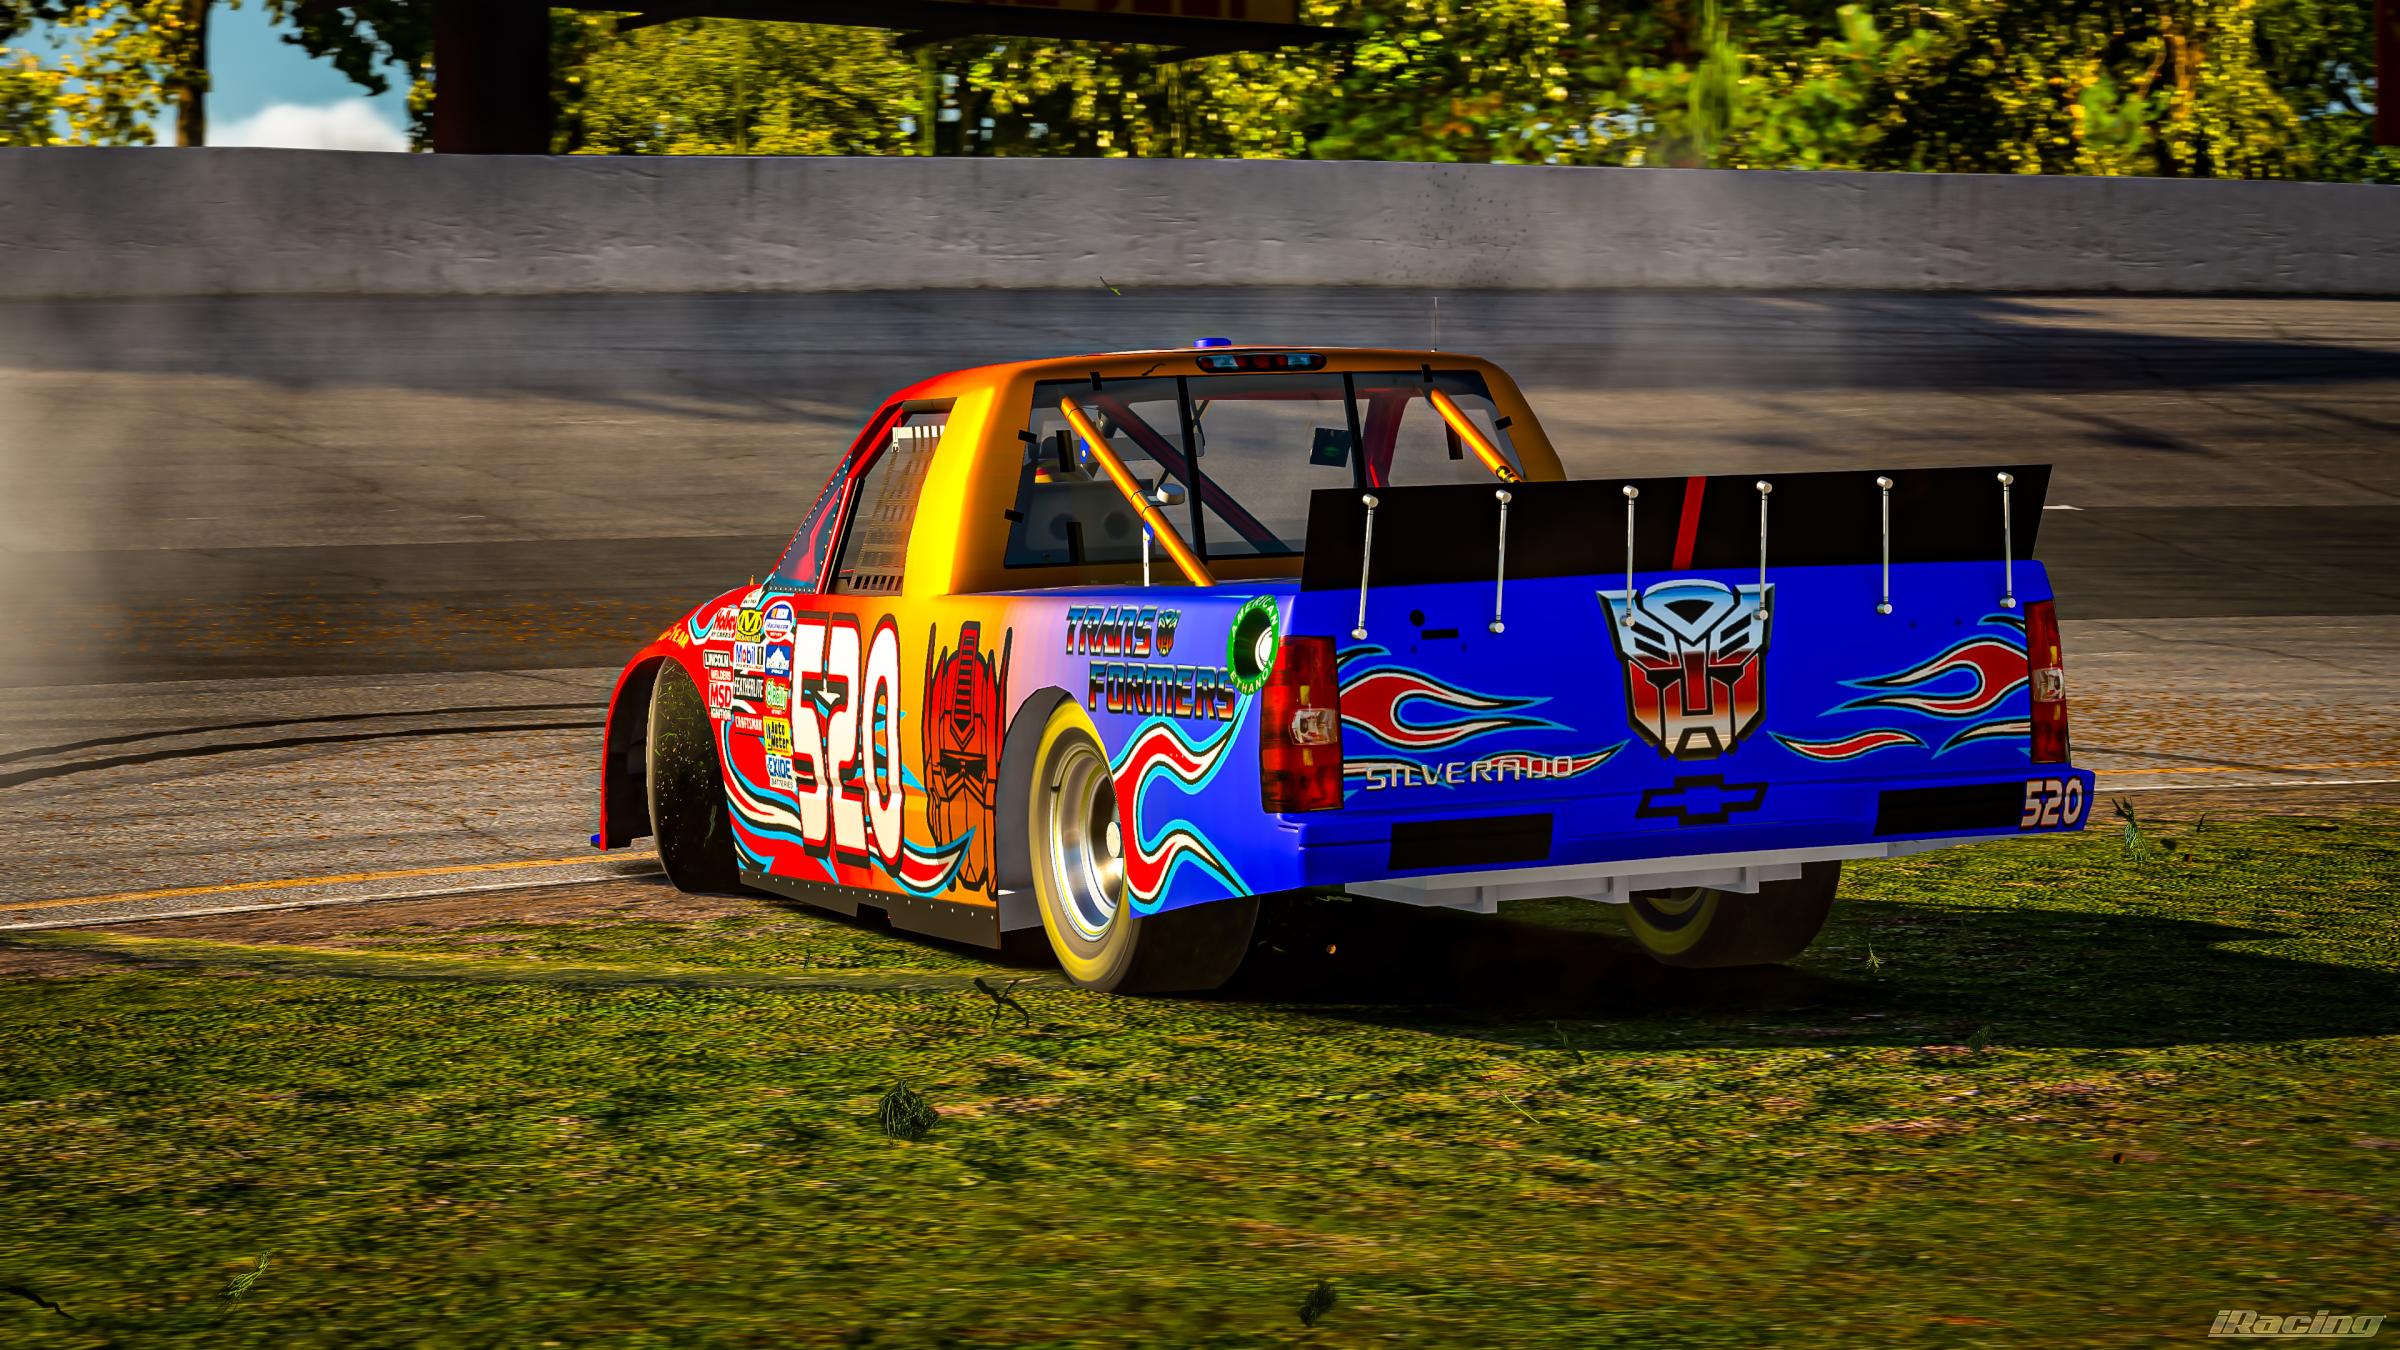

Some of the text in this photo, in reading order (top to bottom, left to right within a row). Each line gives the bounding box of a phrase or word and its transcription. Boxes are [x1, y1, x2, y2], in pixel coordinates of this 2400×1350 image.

[1066, 604, 1158, 658] TRANS
[1231, 597, 1279, 643] AMERICAN
[704, 653, 729, 668] LINCOLN
[736, 643, 755, 665] Mobil
[757, 645, 764, 666] 1
[710, 669, 732, 681] WELDERS
[1230, 660, 1274, 693] ETHANOL
[710, 683, 732, 708] MSD
[734, 676, 764, 698] FEATHERLITE
[1088, 660, 1235, 721] FORMERS
[735, 715, 763, 732] CRAFTSMAN
[771, 721, 785, 736] Auto
[771, 734, 789, 750] Meter
[791, 610, 905, 869] 520
[768, 757, 793, 780] EXIDE
[1366, 756, 1574, 790] SILVERADO
[770, 777, 794, 789] BATTERIES
[2021, 776, 2083, 828] 520
